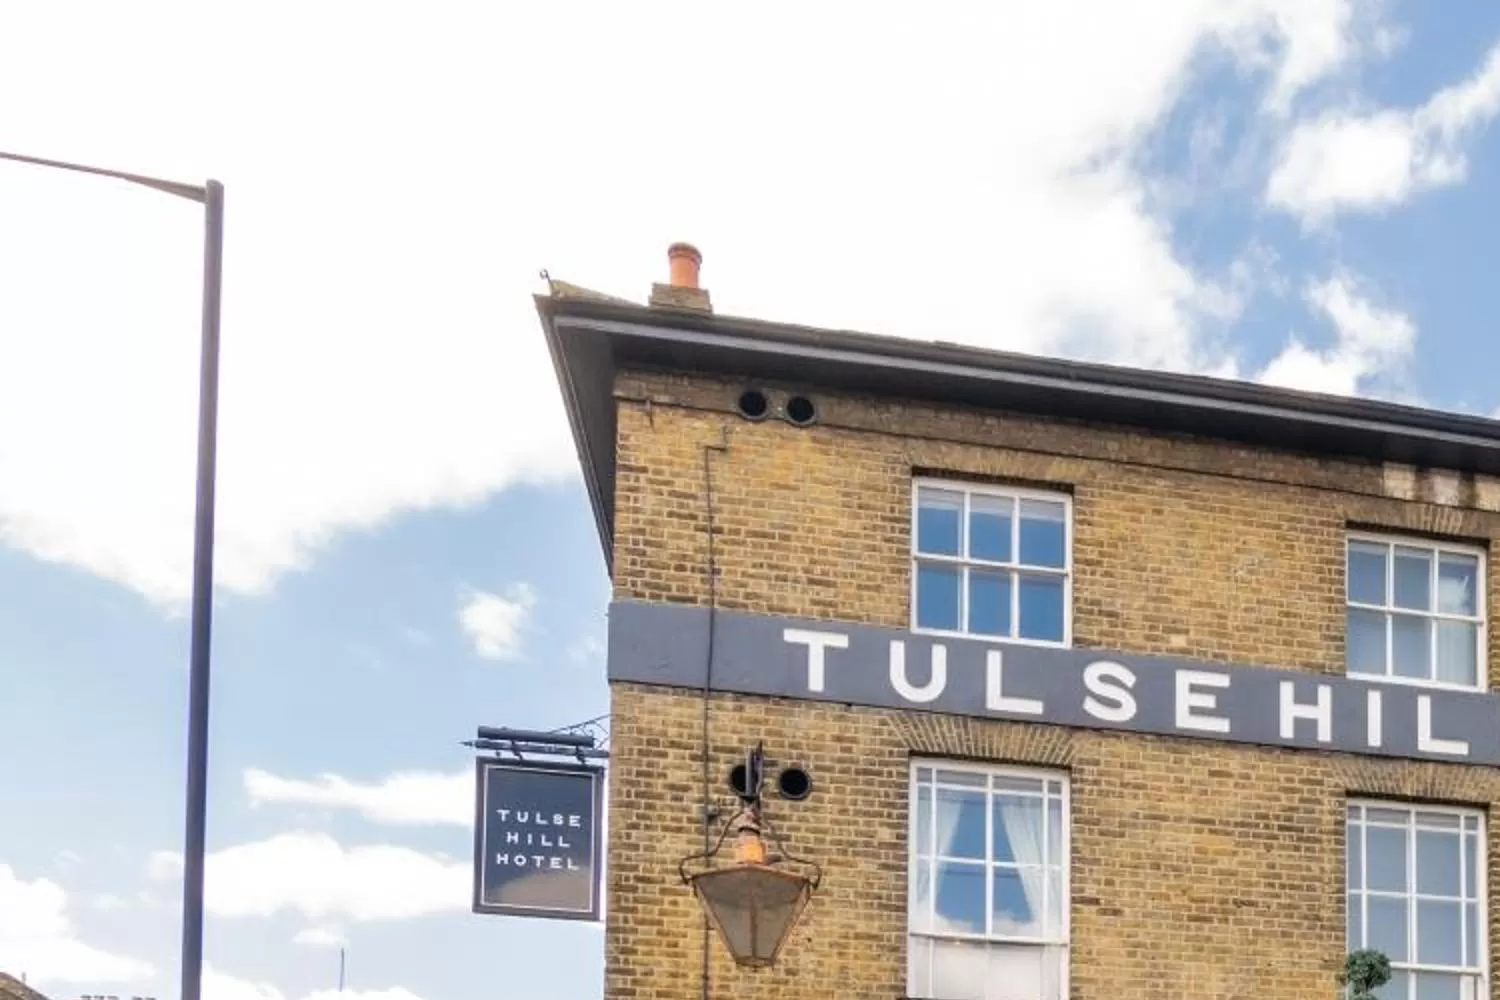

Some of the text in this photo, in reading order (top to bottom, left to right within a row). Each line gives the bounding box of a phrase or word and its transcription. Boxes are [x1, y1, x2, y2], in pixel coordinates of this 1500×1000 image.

[783, 627, 1231, 733] TULSE
[496, 809, 581, 827] TULSE
[506, 832, 570, 847] HILL
[496, 853, 580, 871] HOTEL
